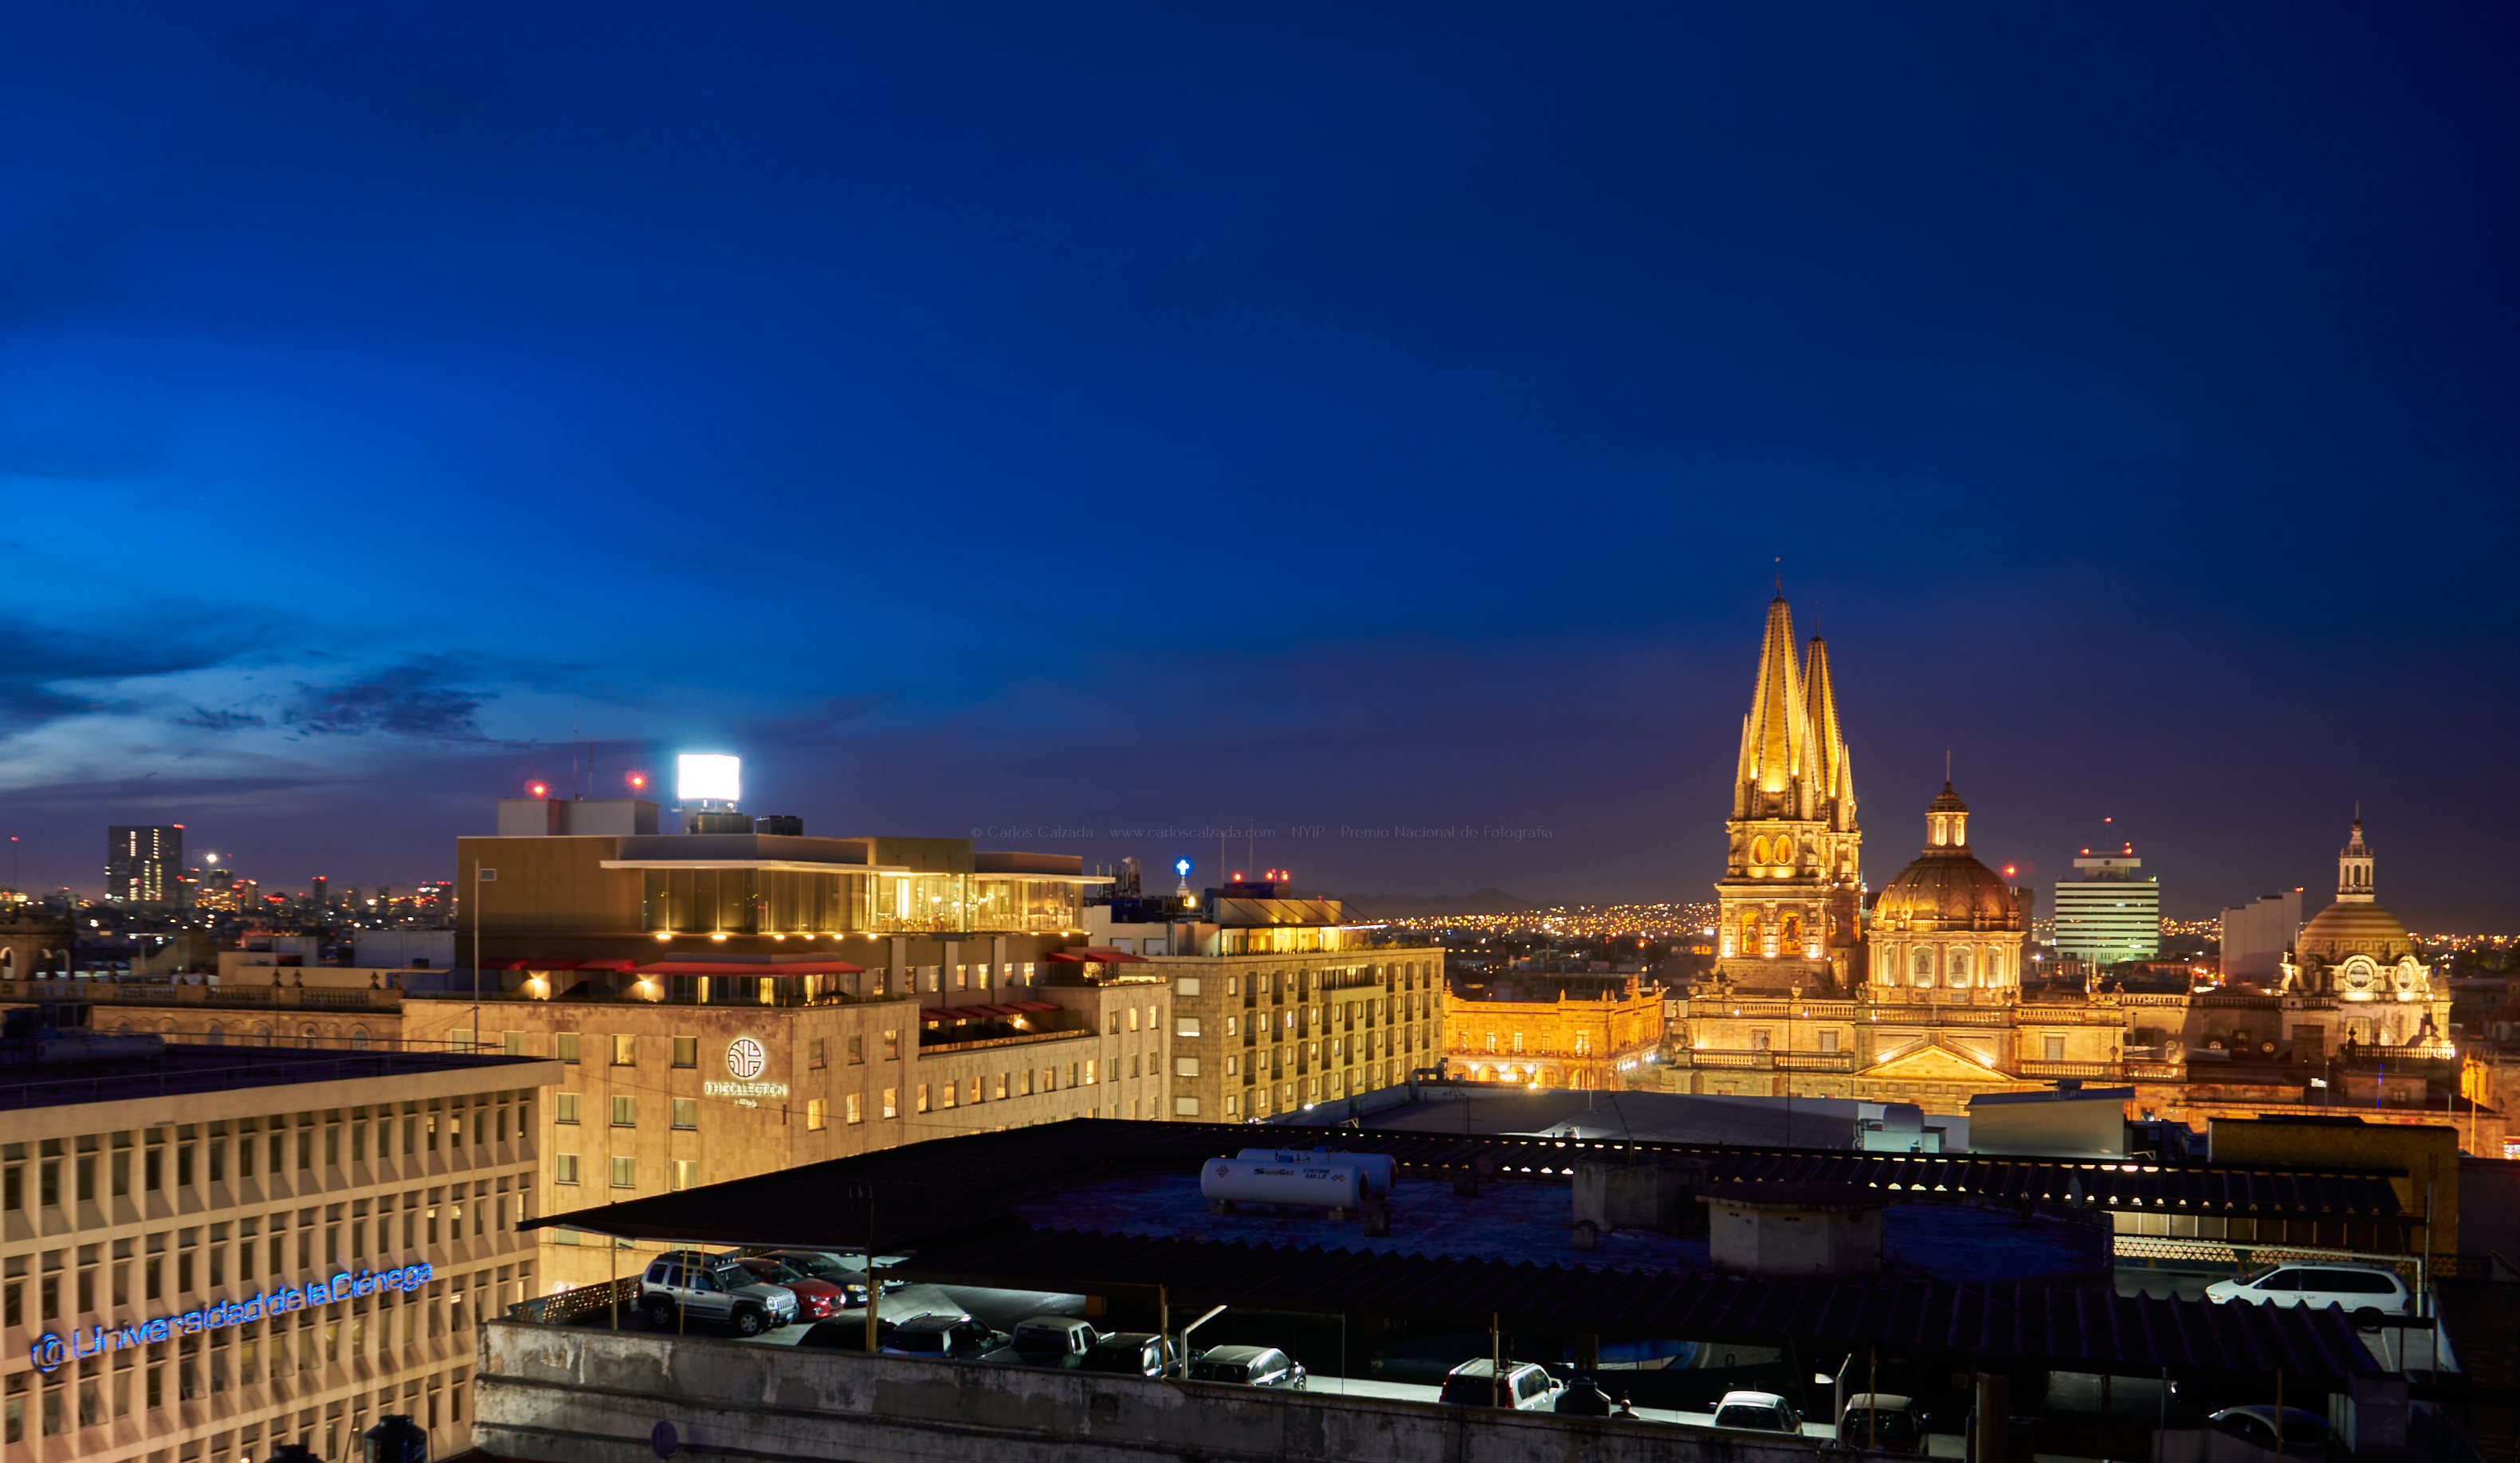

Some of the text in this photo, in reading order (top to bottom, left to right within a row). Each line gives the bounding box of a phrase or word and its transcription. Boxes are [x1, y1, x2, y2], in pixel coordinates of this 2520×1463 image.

[720, 1082, 786, 1096] COLLECTION
[73, 1262, 433, 1359] Universidad de la Ciénega
